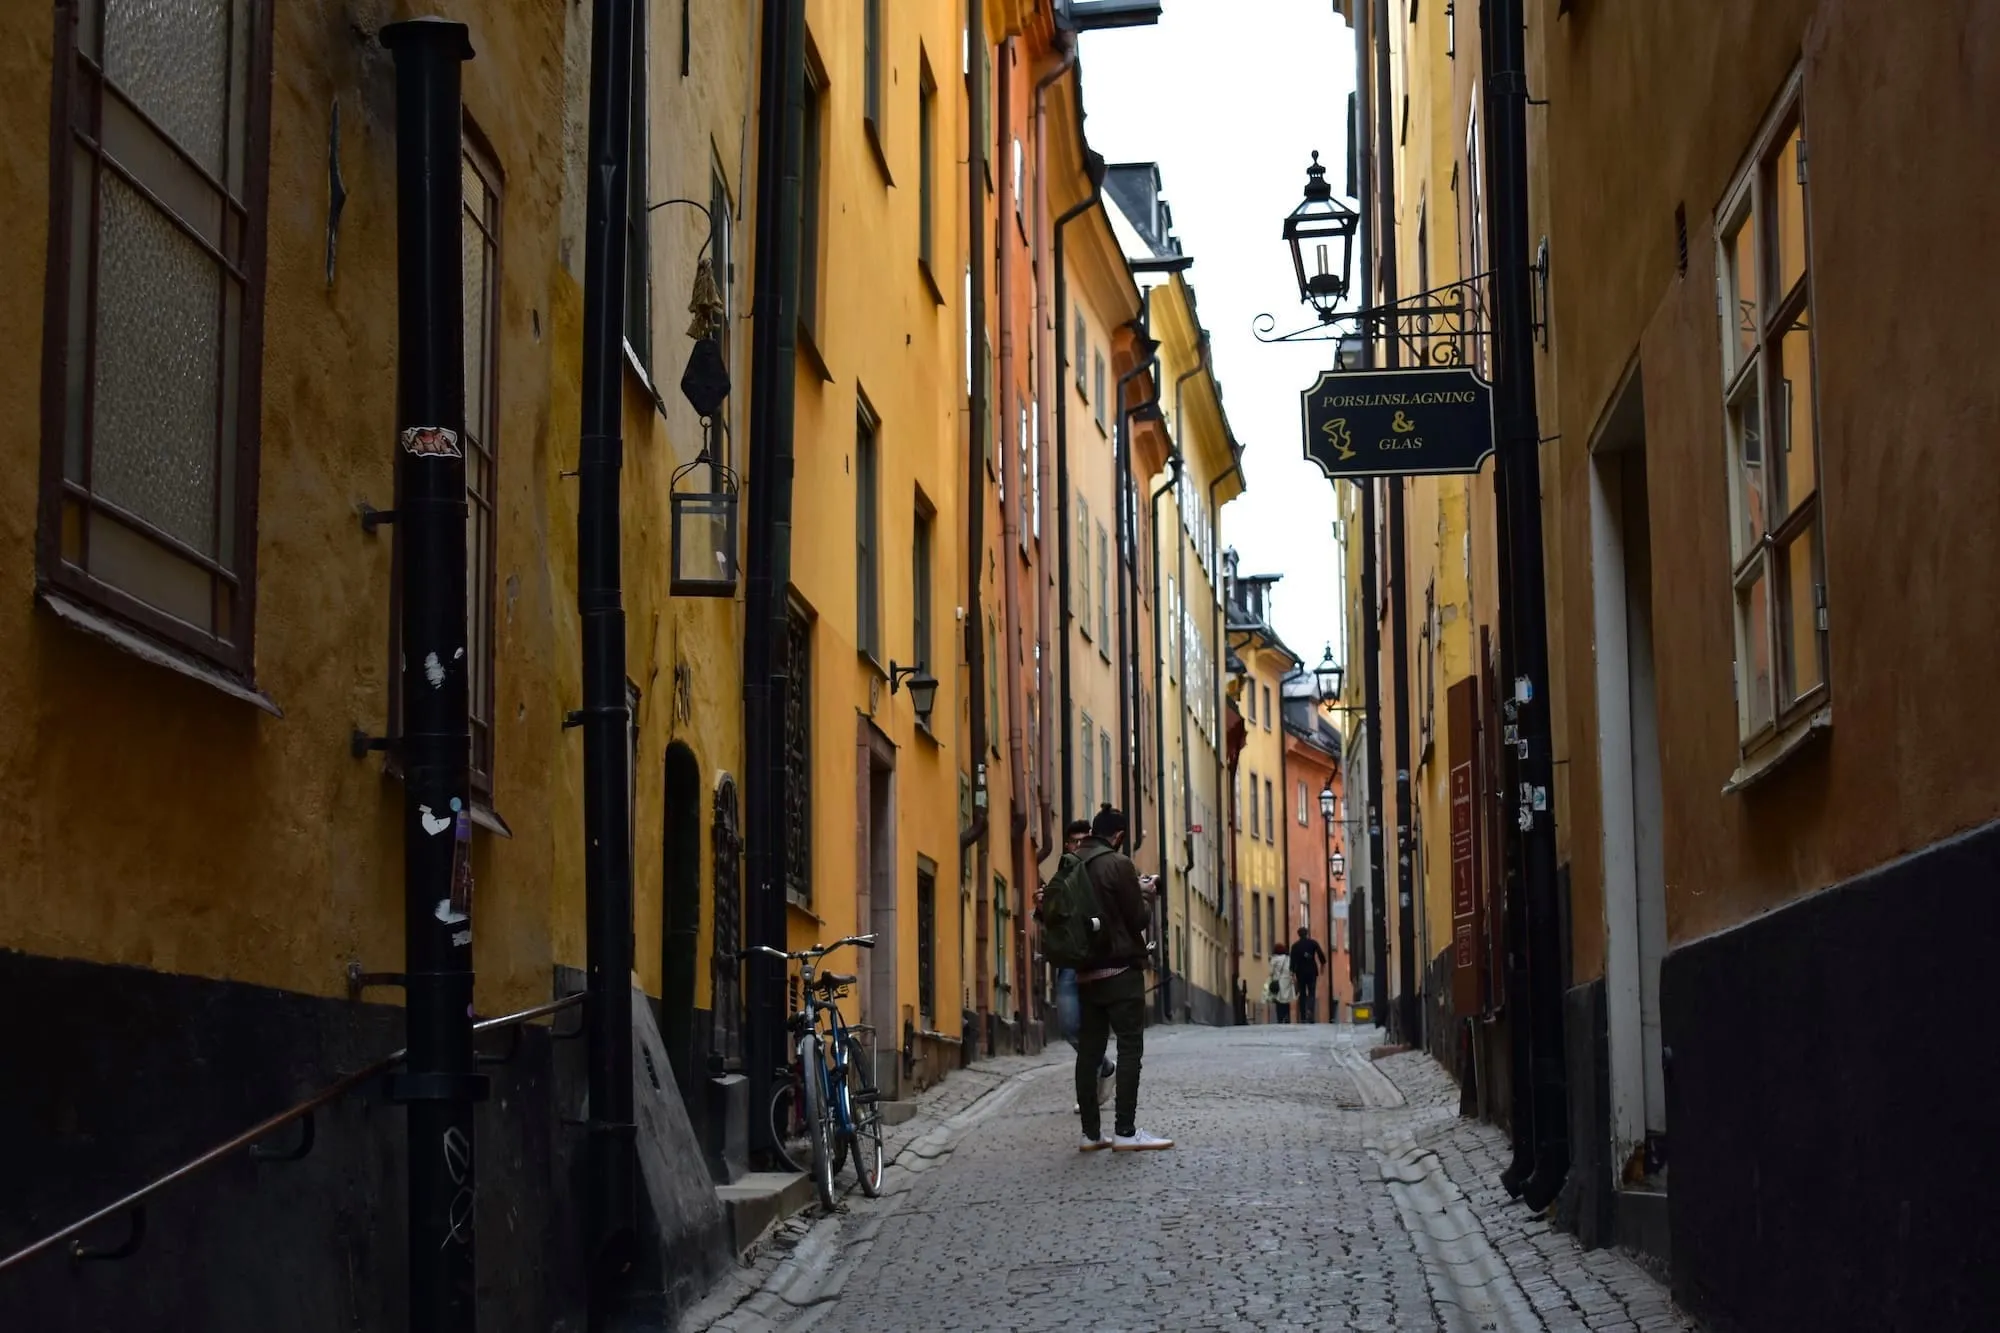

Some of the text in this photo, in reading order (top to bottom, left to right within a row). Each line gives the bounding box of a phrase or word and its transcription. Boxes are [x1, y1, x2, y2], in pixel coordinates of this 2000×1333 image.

[1322, 391, 1476, 408] PORSLINSLAGNING
[1391, 409, 1415, 433] &
[1378, 436, 1424, 451] GLAS
